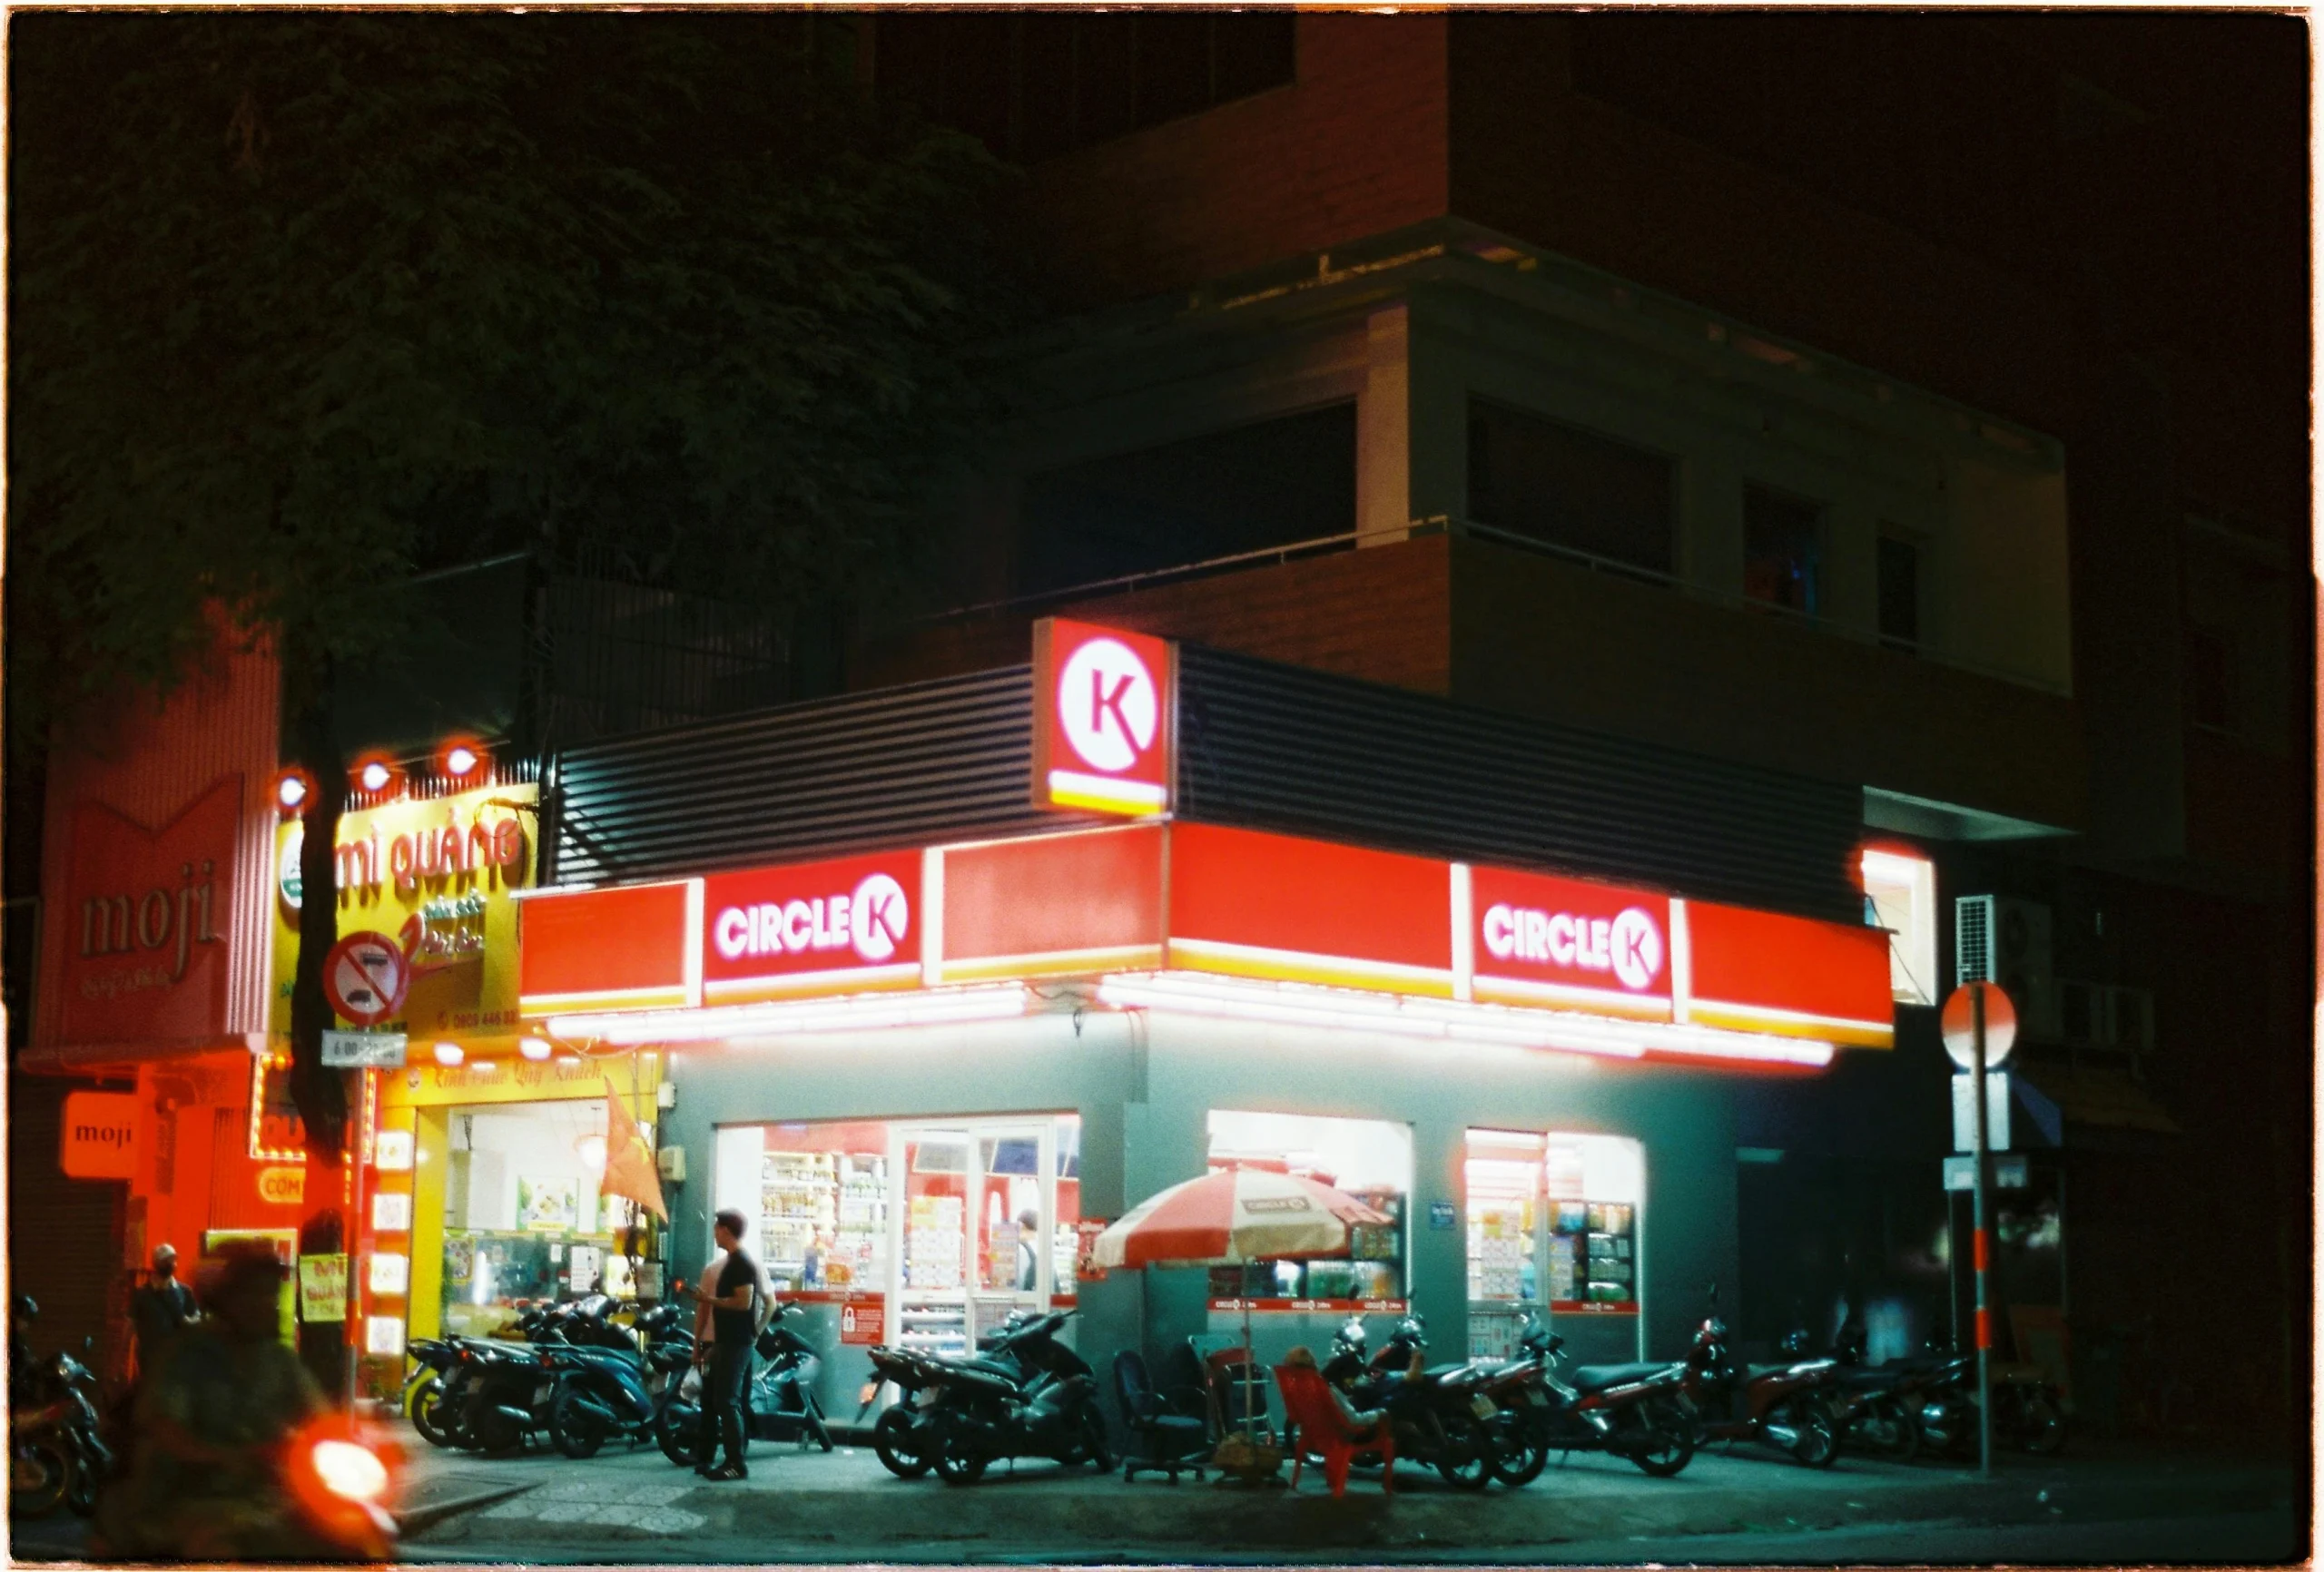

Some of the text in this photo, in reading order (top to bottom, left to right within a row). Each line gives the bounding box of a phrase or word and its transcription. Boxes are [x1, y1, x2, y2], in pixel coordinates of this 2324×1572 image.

[81, 860, 214, 983] moji
[715, 895, 851, 958] CIRCLE
[1483, 904, 1610, 968] CIRCLE
[75, 1121, 132, 1151] moji
